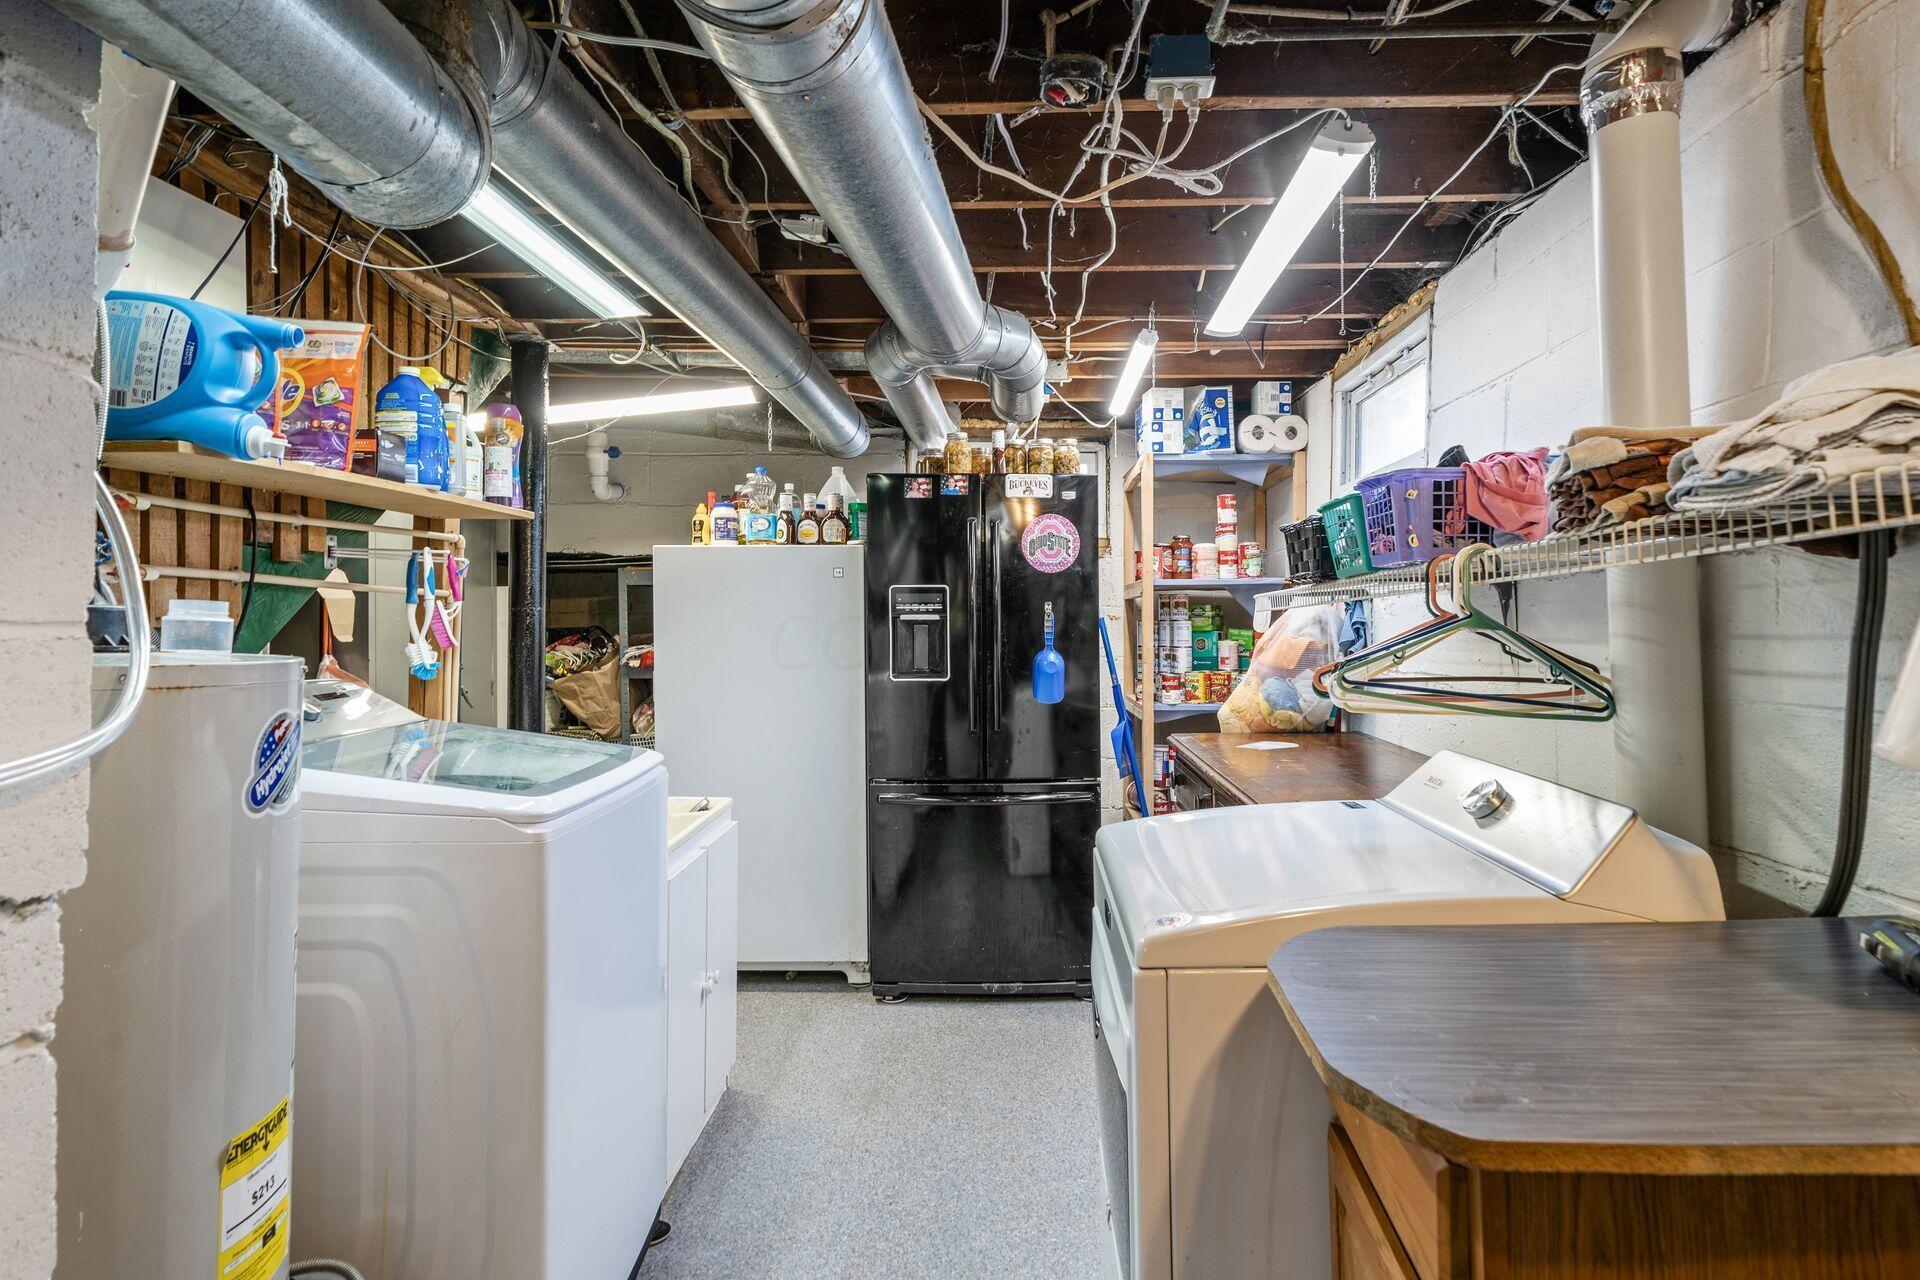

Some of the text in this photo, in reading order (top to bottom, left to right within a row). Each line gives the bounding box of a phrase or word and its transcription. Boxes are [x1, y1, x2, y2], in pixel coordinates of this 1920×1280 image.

[1009, 479, 1048, 490] BUCKEYES
[1028, 531, 1072, 557] OHIO STATE
